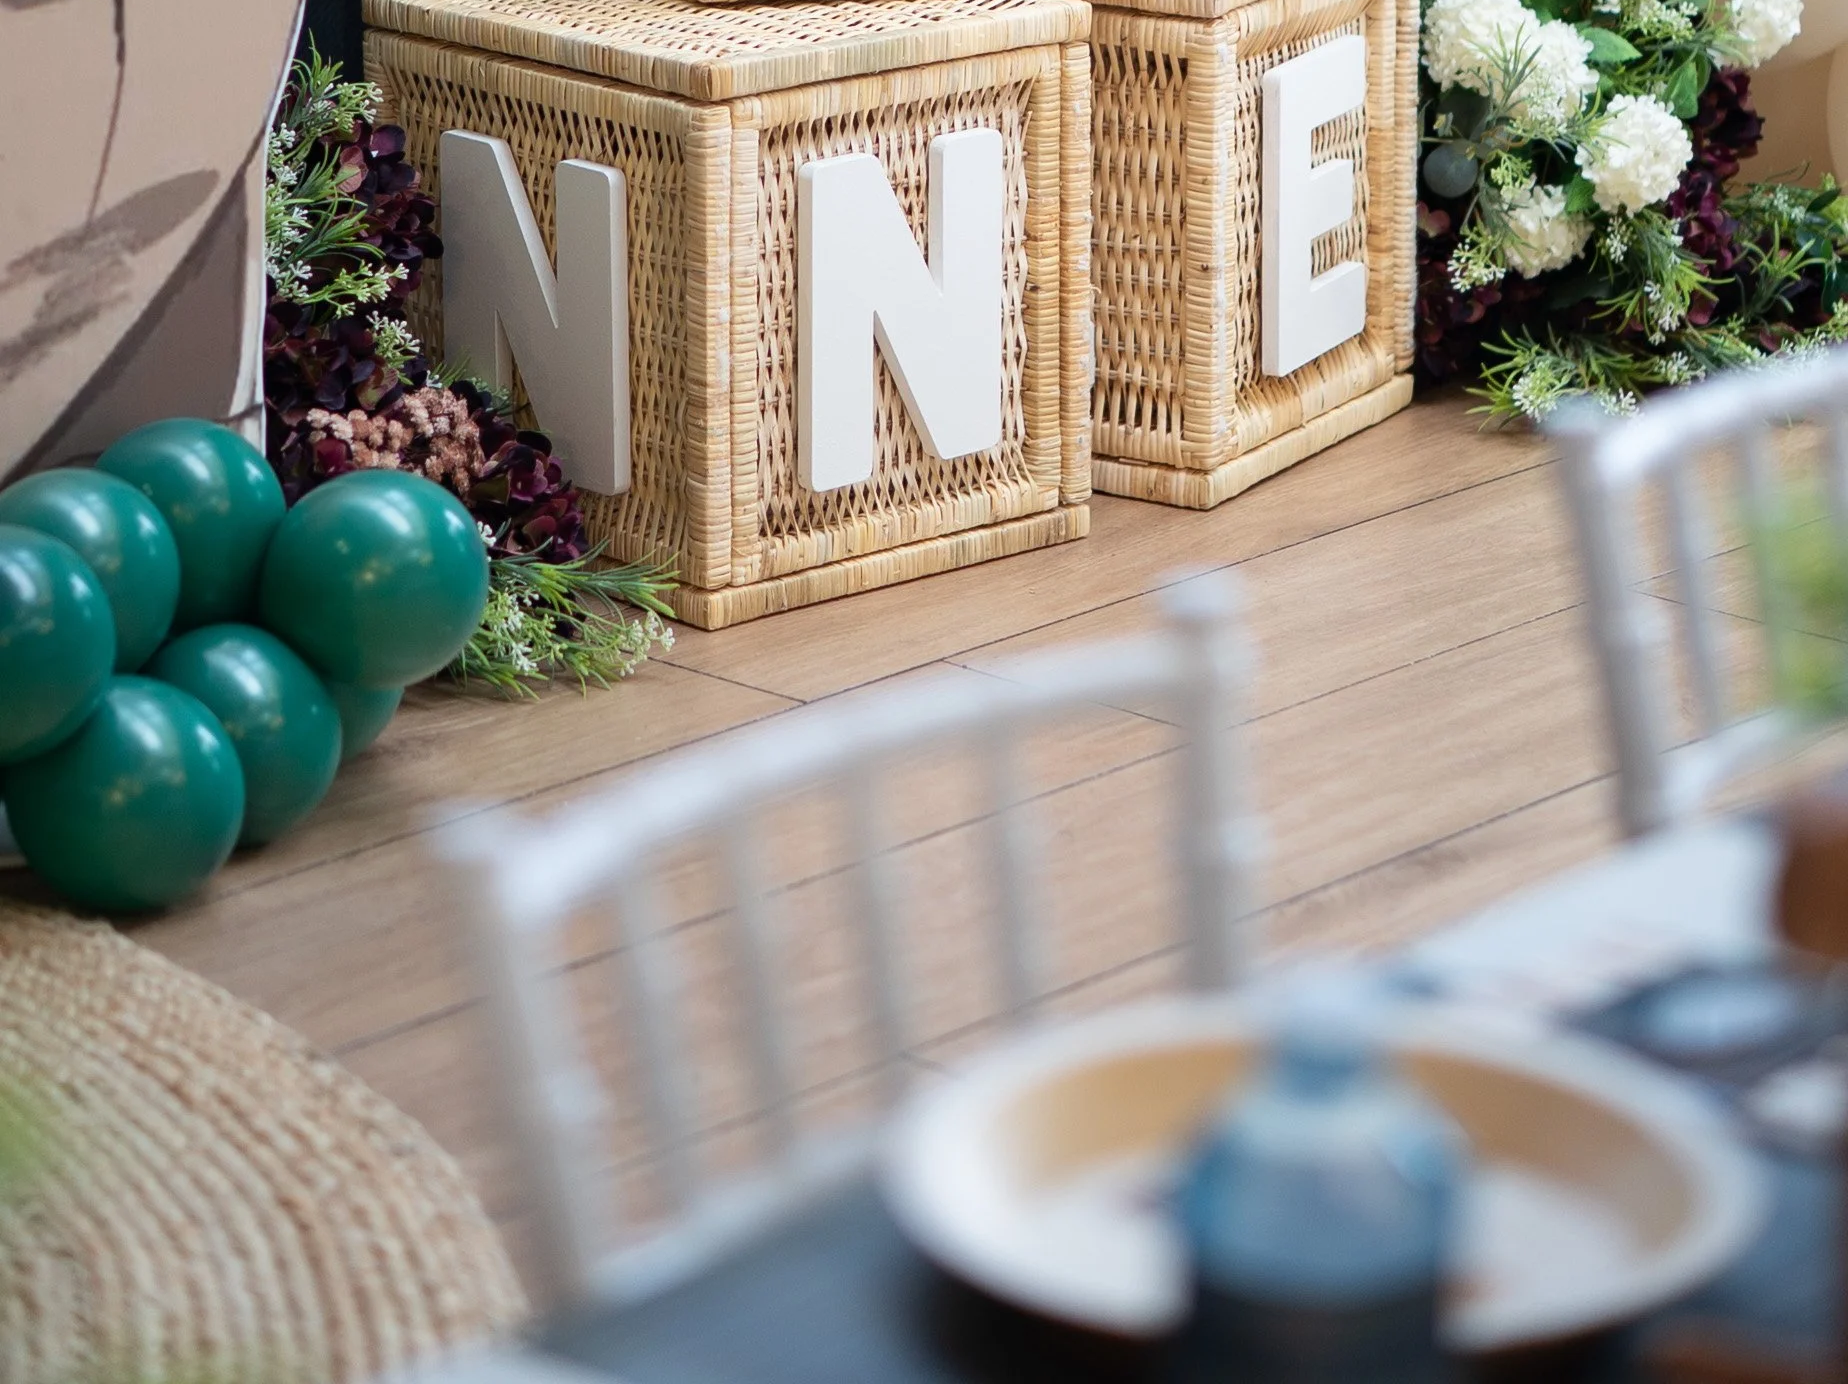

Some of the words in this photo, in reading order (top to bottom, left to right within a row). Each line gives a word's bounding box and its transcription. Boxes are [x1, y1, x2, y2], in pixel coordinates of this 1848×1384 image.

[439, 129, 628, 495] N
[800, 127, 1002, 492] N
[1261, 35, 1367, 377] E
